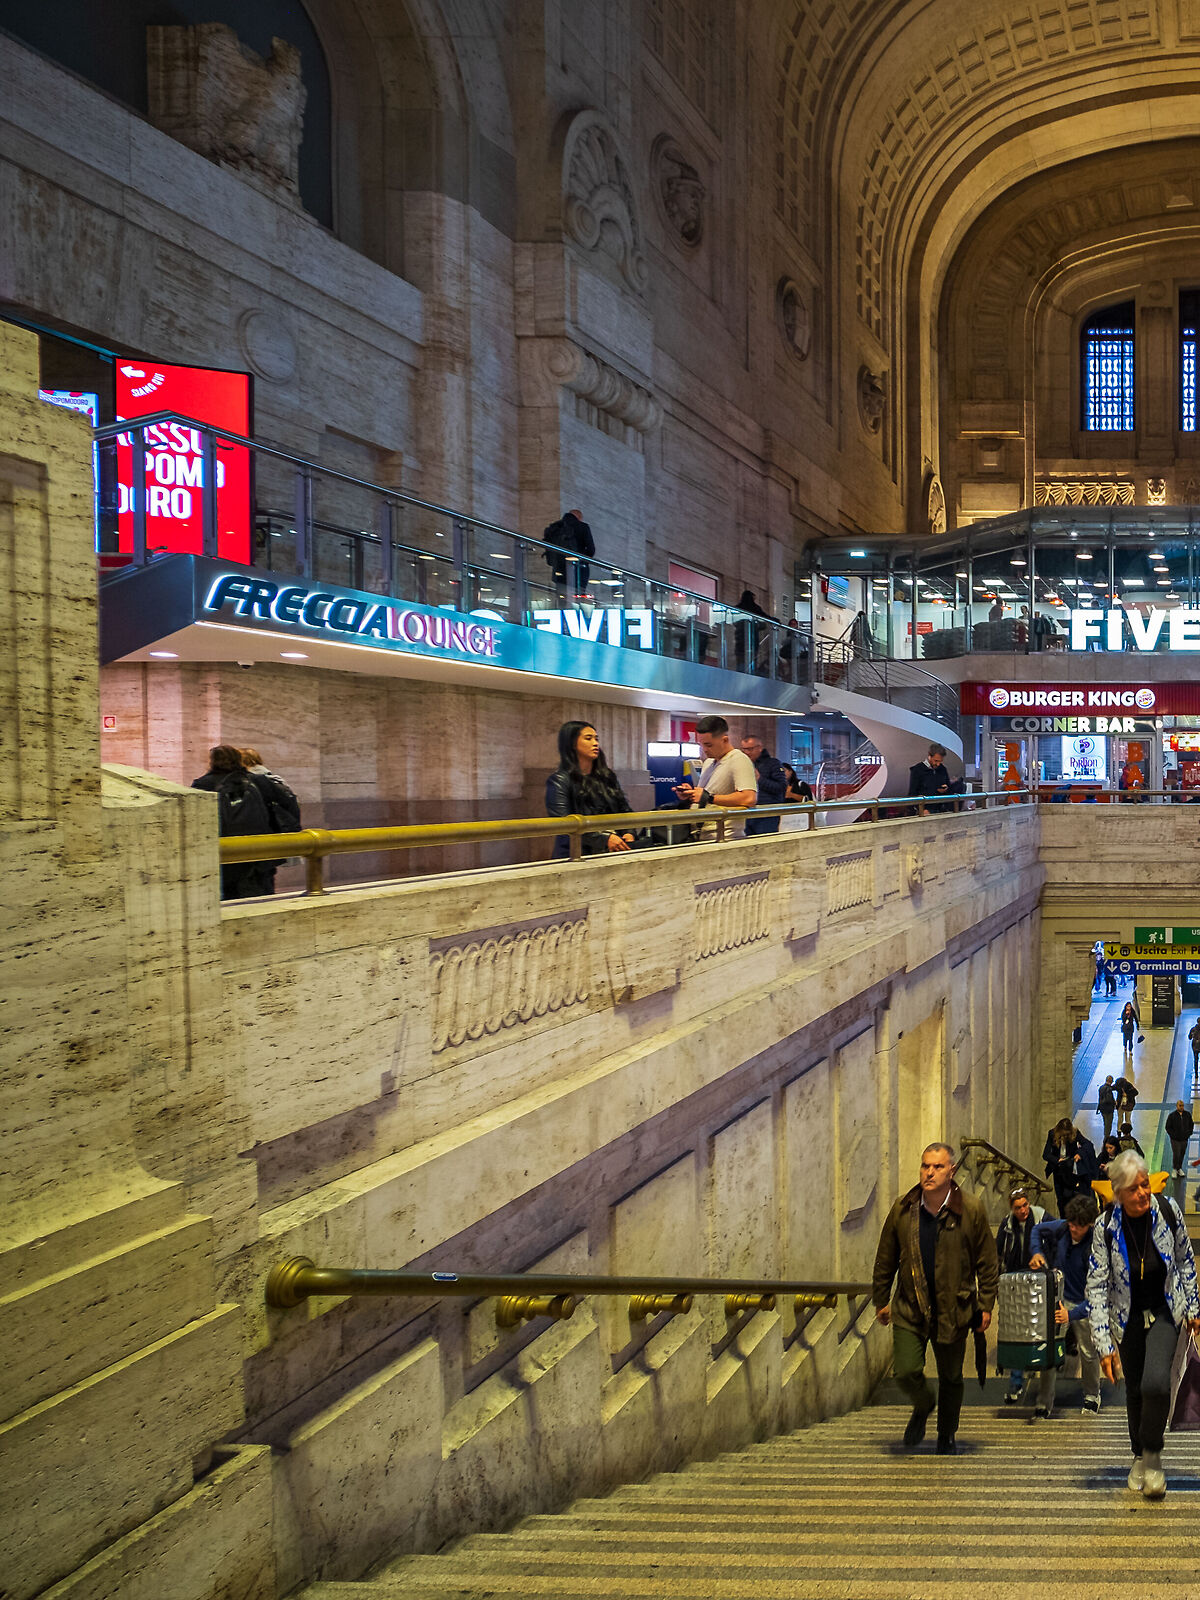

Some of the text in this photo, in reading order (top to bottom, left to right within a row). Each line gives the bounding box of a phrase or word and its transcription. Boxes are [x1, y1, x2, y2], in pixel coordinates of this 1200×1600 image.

[1010, 691, 1135, 706] BURGER KING
[1010, 717, 1136, 732] CORNER BAR
[1135, 946, 1167, 955] Uscita
[1171, 946, 1186, 955] Exit
[1134, 961, 1182, 971] Terminal
